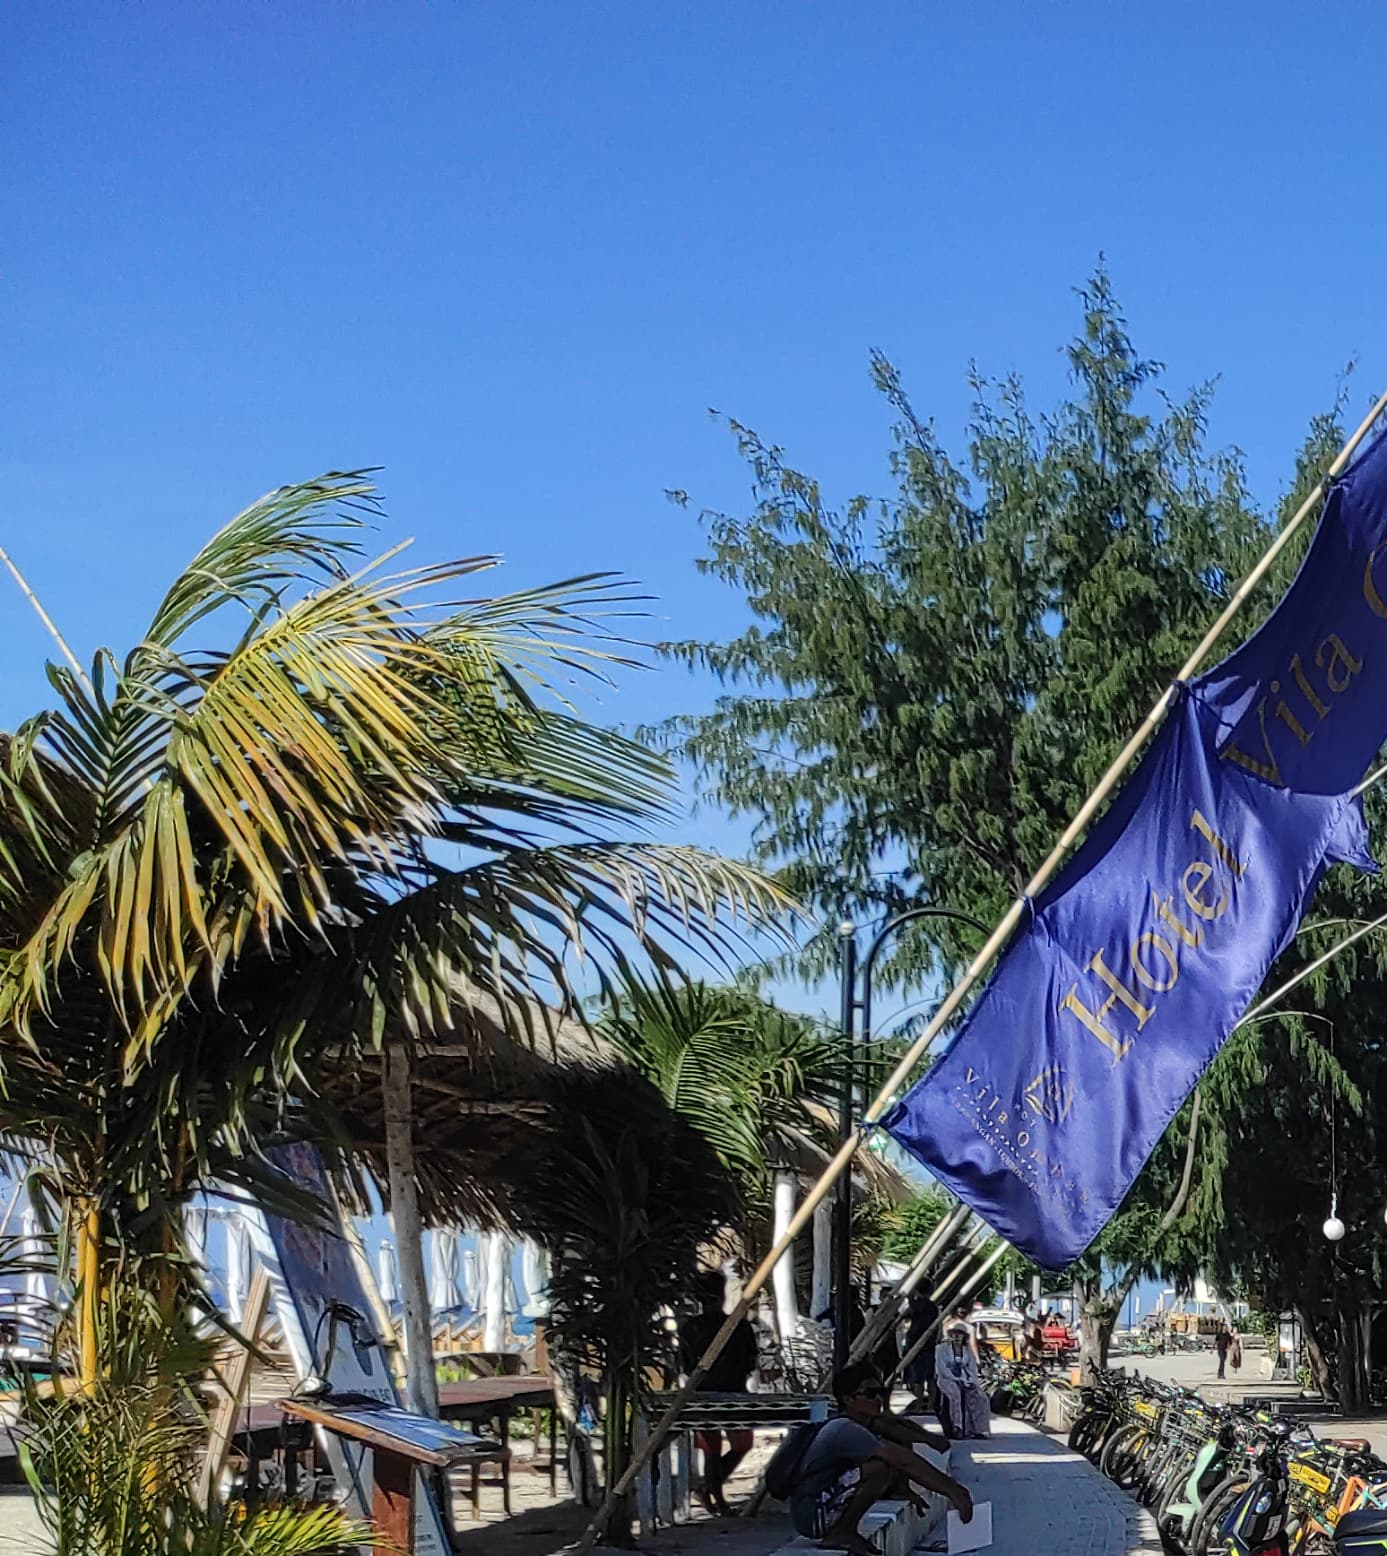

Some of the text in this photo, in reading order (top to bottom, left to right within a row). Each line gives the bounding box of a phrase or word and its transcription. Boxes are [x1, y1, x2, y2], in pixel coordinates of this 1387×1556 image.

[1057, 808, 1249, 1068] Hotel
[1218, 633, 1364, 787] Vila
[965, 1067, 1008, 1125] Vila
